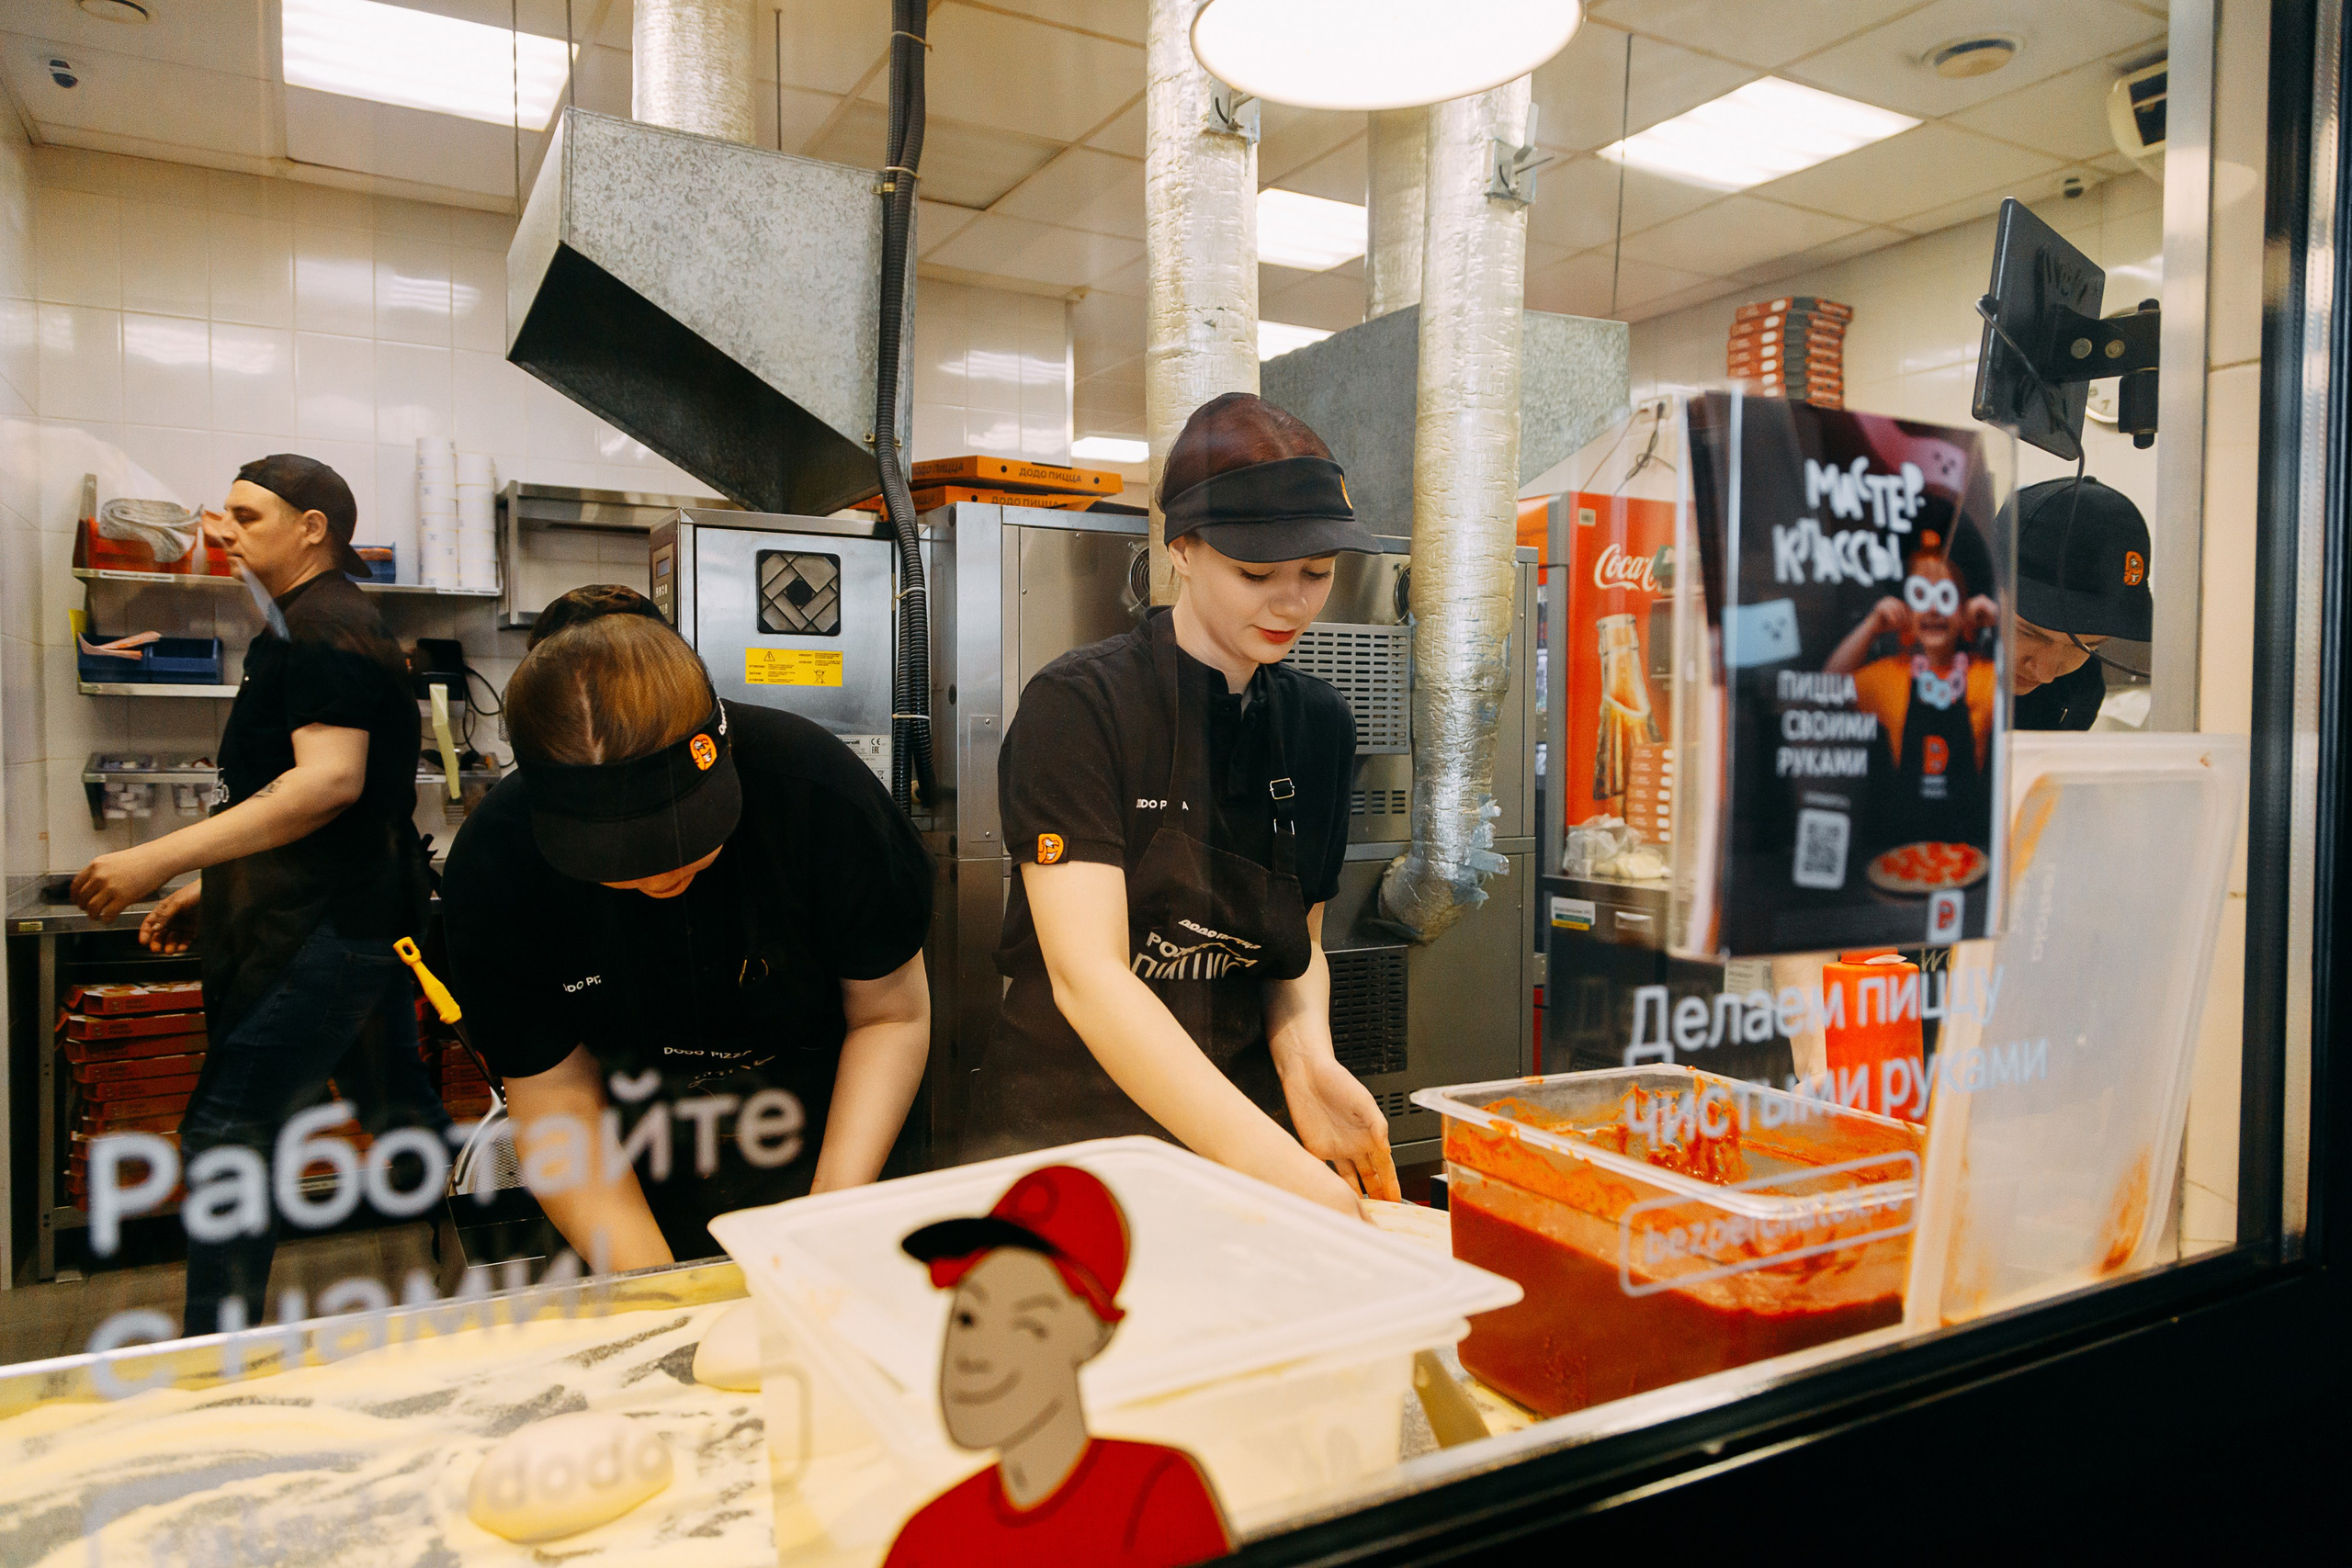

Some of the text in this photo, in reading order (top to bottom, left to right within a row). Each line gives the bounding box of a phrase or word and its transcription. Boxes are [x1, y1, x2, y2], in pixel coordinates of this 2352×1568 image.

[1019, 467, 1082, 483] ДОДО ПИЦЦА
[991, 496, 1022, 506] ДОДО
[1594, 543, 1663, 592] Coca-C
[1771, 516, 1905, 587] КЛАССЫ
[1777, 669, 1859, 706] ПИЦЦА
[1781, 708, 1879, 742] СВОИМИ
[1775, 747, 1869, 778] РУКАМИ
[1136, 798, 1158, 808] DO
[1623, 964, 2005, 1066] Делаем пиццу
[1624, 1038, 2050, 1147] чистыми руками
[87, 1068, 808, 1258] Работайте
[86, 1310, 178, 1402] с
